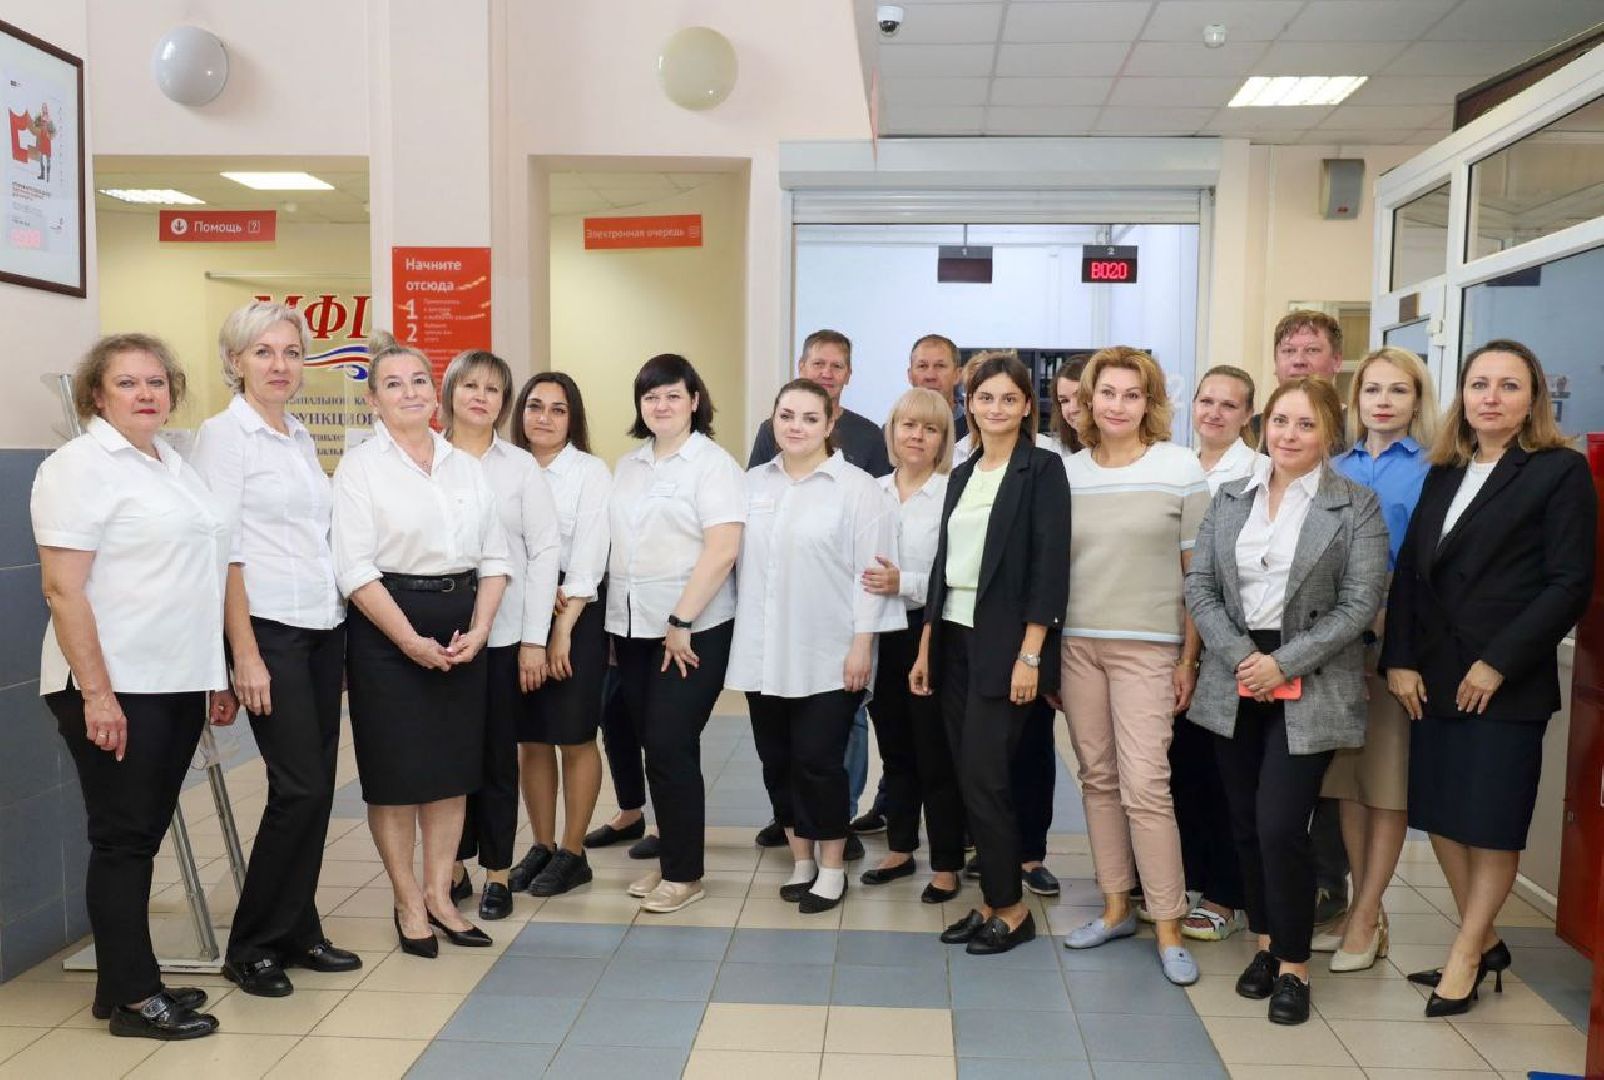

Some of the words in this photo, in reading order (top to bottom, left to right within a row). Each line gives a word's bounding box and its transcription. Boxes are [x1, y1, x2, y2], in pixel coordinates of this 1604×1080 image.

[194, 221, 242, 234] Помощь
[1107, 247, 1115, 255] 2
[405, 258, 462, 271] Начните
[405, 281, 454, 293] отсюда
[406, 299, 418, 320] 1
[407, 323, 417, 343] 2
